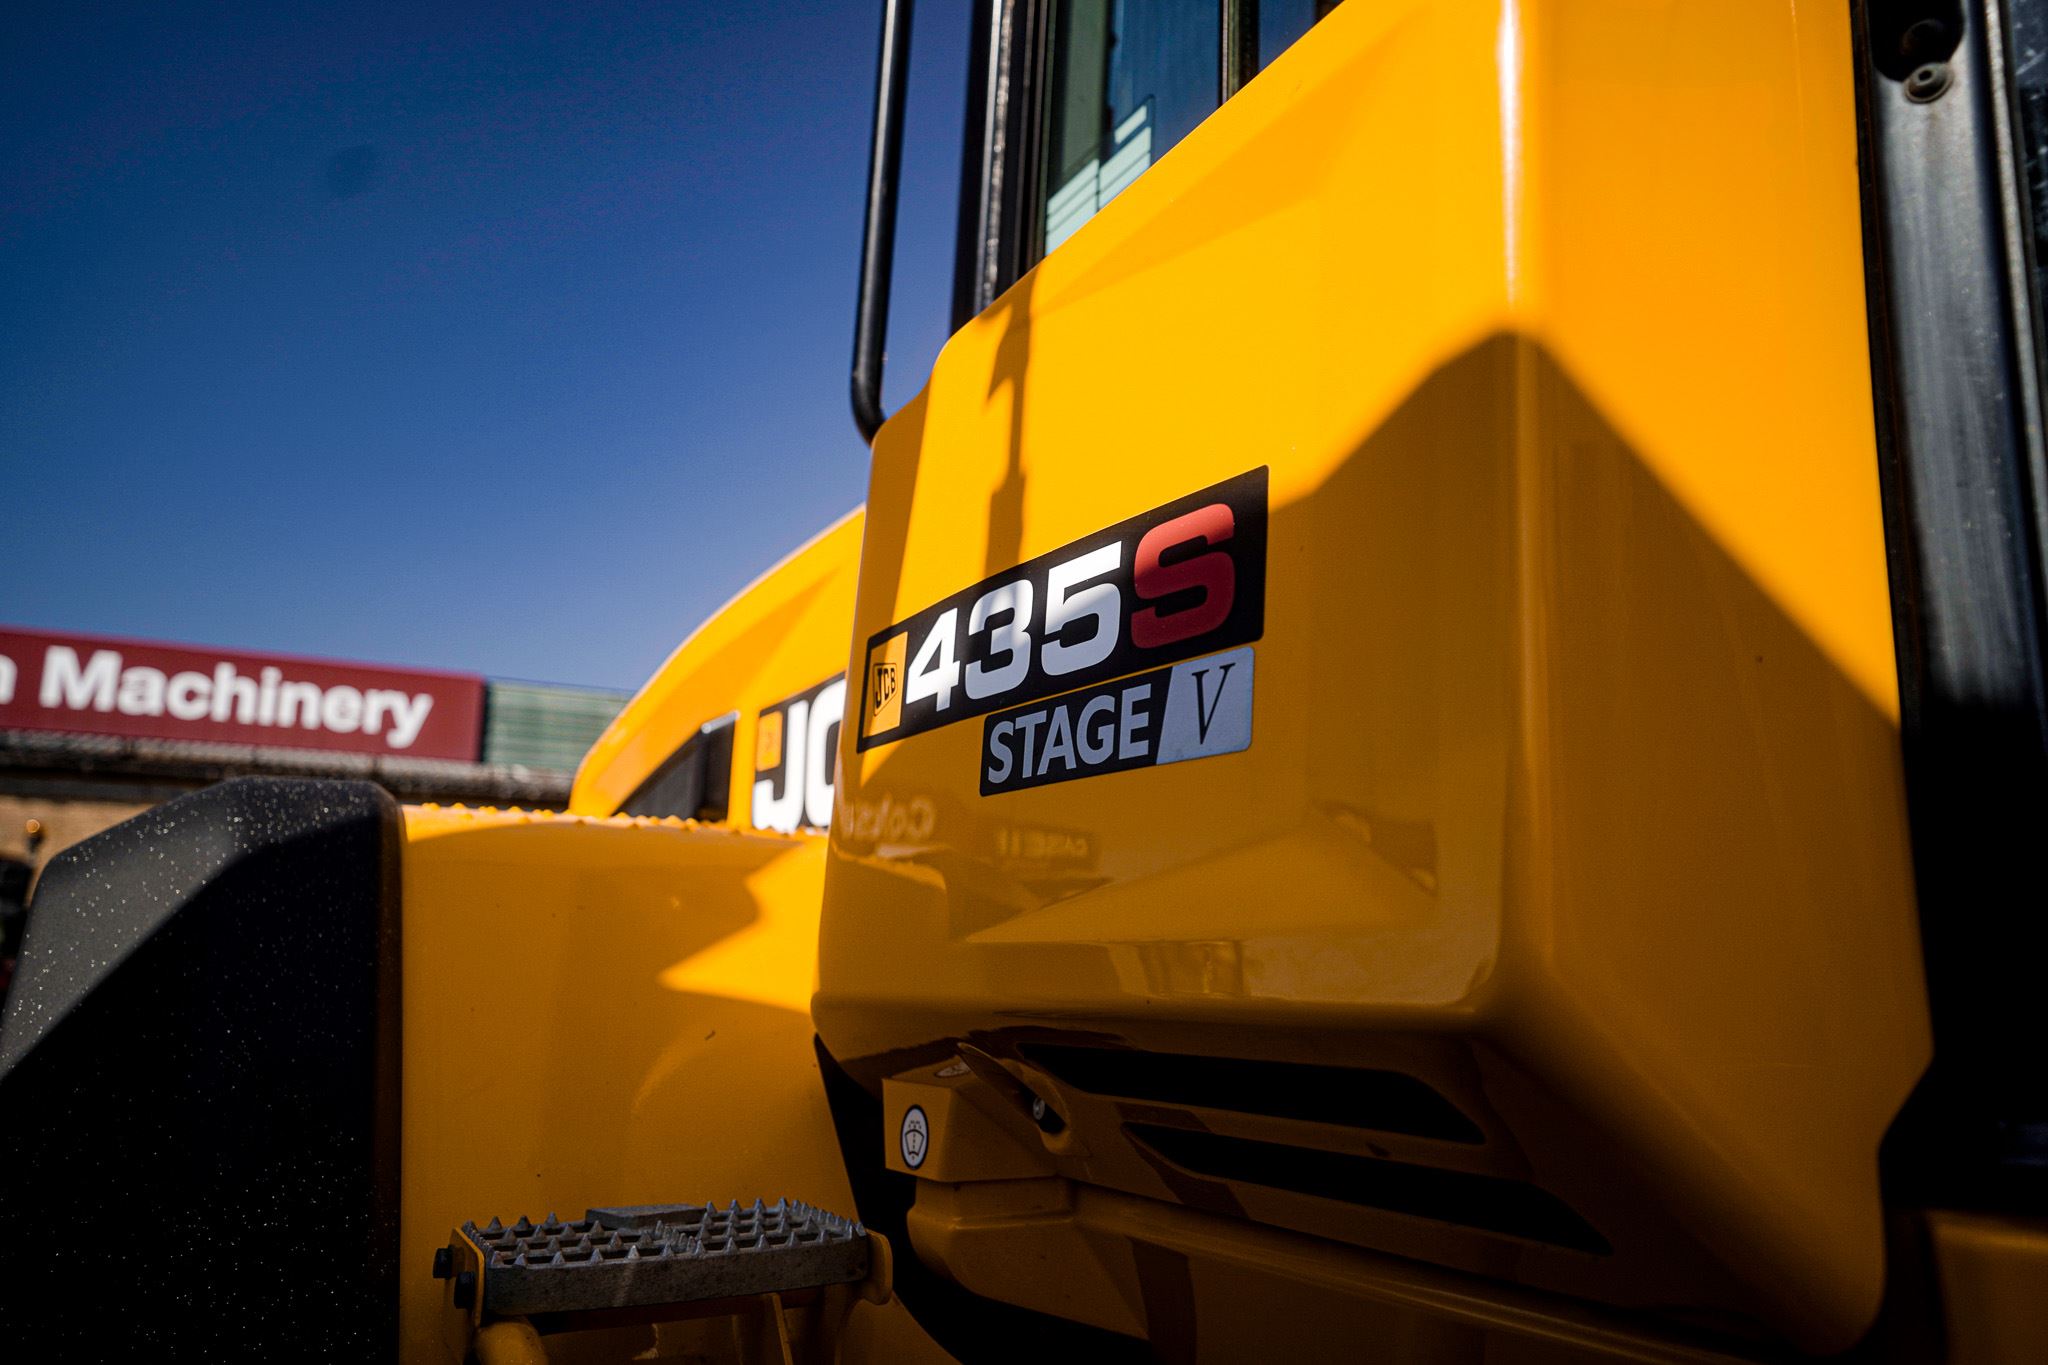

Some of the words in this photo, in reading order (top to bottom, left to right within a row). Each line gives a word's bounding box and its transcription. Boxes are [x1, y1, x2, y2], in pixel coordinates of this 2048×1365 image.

[874, 667, 896, 710] JCB
[905, 503, 1236, 712] 435S
[40, 645, 434, 749] Machinery
[987, 683, 1153, 784] STAGE
[1191, 661, 1236, 746] V
